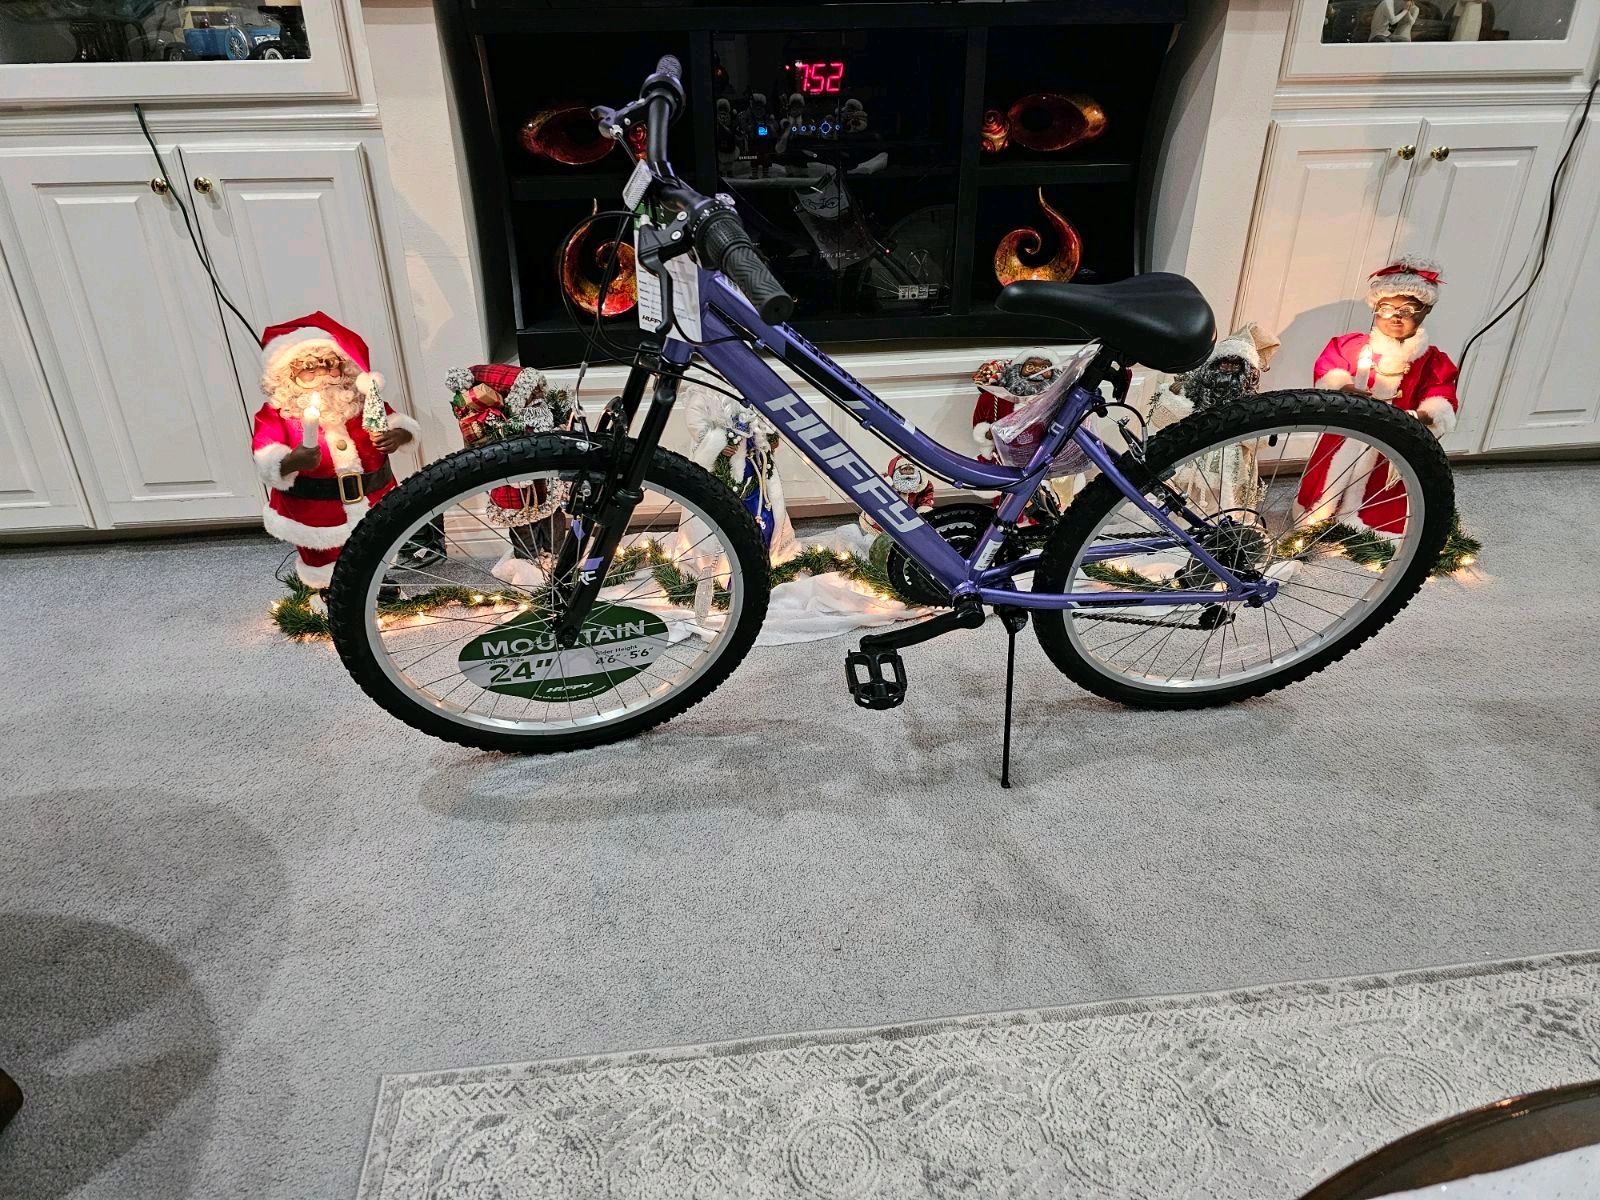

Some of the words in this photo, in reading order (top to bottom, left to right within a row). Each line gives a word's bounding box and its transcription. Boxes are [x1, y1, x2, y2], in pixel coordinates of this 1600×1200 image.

[765, 393, 925, 533] HUFFY
[482, 620, 645, 657] MOUTAIN
[615, 644, 639, 655] Height
